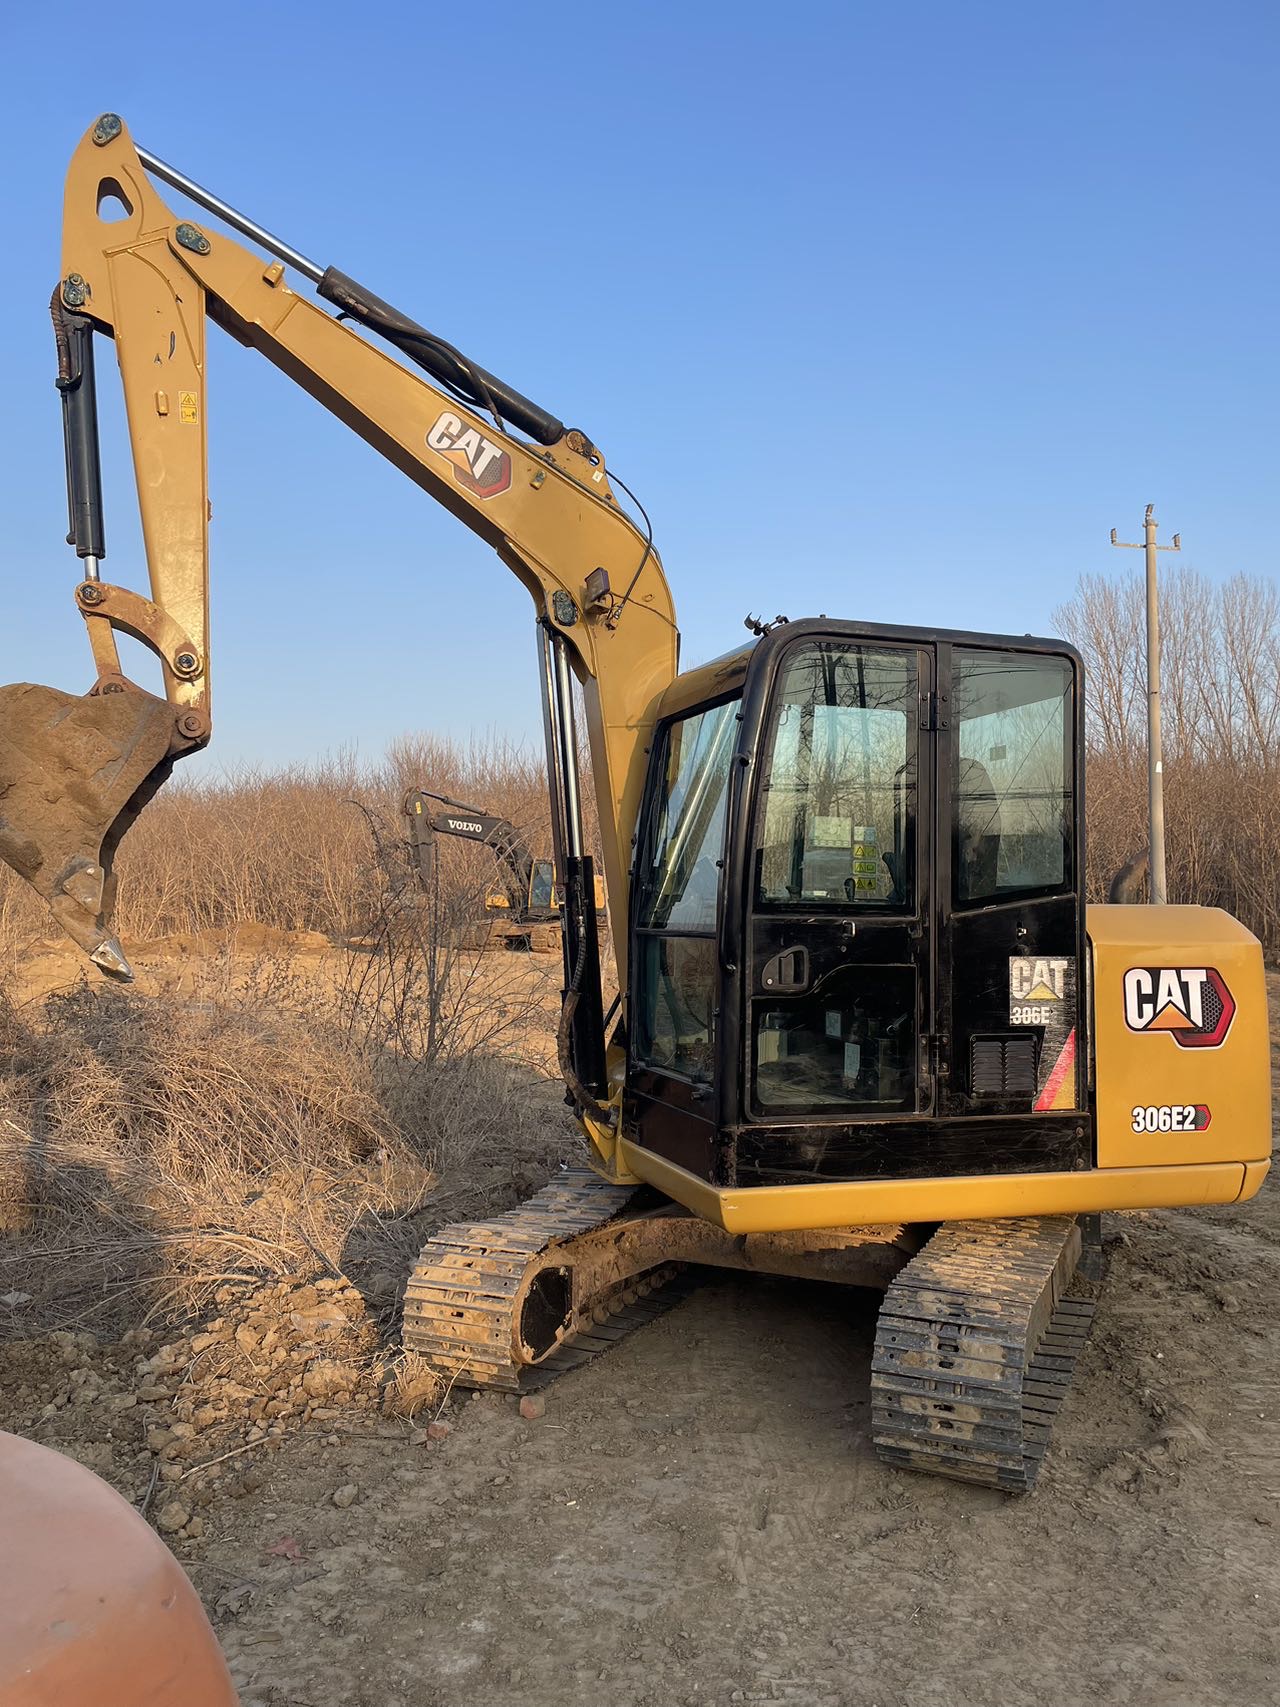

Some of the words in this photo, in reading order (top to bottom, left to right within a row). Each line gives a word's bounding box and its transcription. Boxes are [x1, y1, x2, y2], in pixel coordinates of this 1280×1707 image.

[427, 412, 503, 479] CAT
[447, 819, 483, 833] VOLVO
[1011, 959, 1068, 999] CAT
[1125, 968, 1207, 1029] CAT
[1132, 1106, 1196, 1132] 306E2
